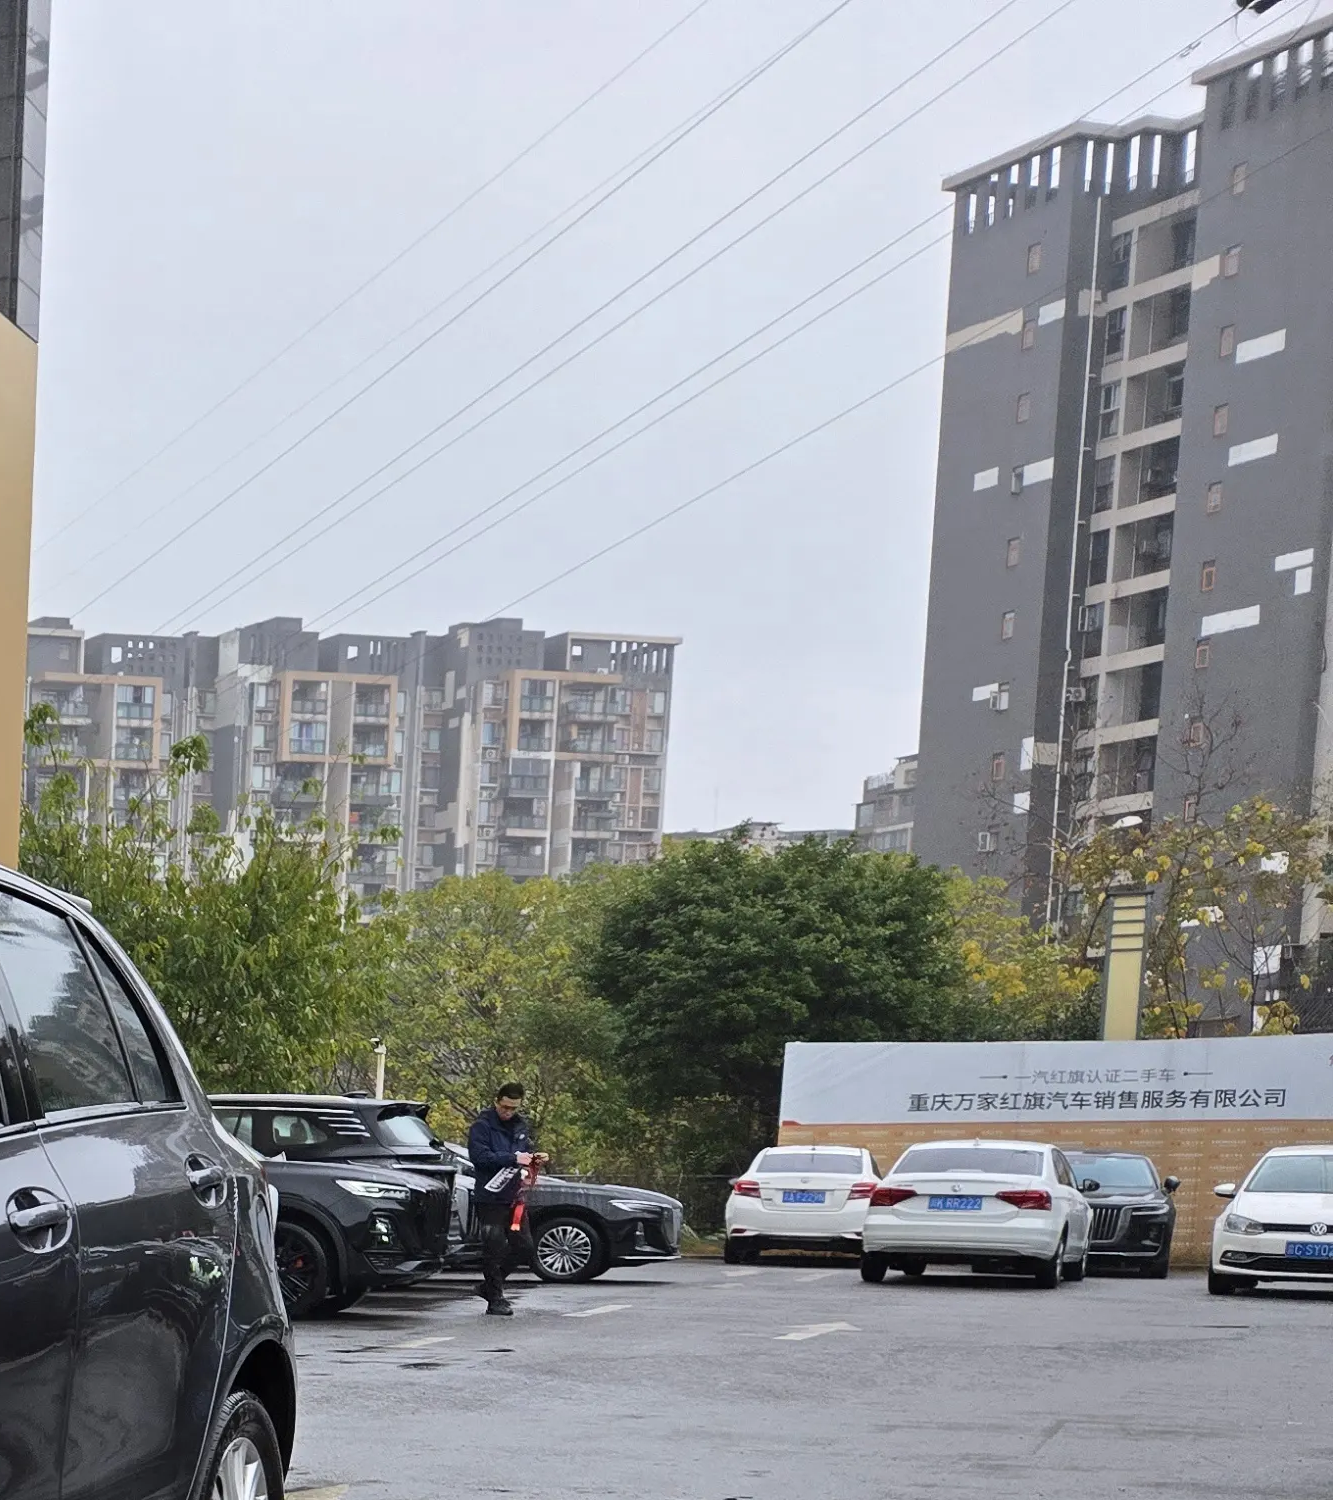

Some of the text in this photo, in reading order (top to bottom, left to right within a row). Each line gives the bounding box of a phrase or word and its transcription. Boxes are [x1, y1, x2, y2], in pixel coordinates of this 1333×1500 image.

[1014, 1068, 1176, 1085] 一汽红旗认证二手车
[907, 1088, 1287, 1113] 重庆万家红旗汽车销售服务有限公司
